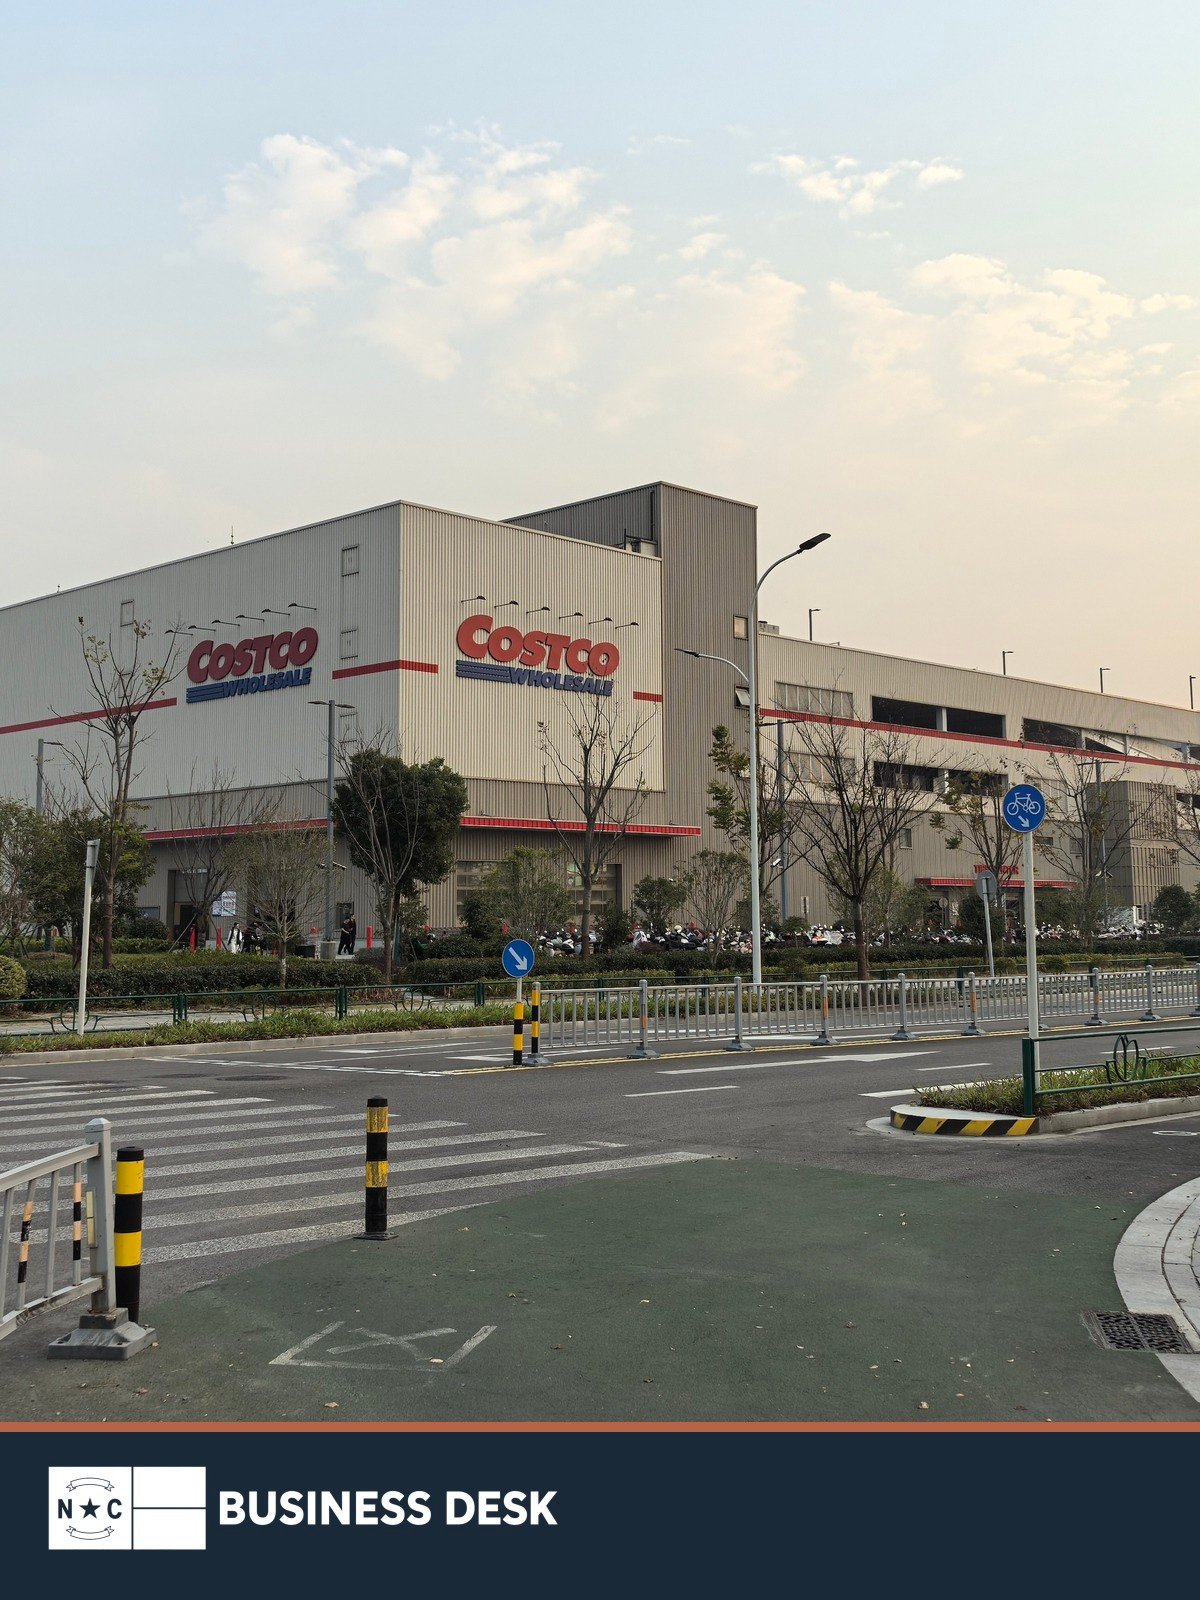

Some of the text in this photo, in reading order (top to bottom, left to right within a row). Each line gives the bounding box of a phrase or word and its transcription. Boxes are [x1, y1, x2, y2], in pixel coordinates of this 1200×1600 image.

[187, 626, 319, 683] COSTCO
[456, 614, 620, 677] COSTCO
[223, 667, 312, 698] WHOLESALE
[509, 666, 614, 697] WHOLESALE
